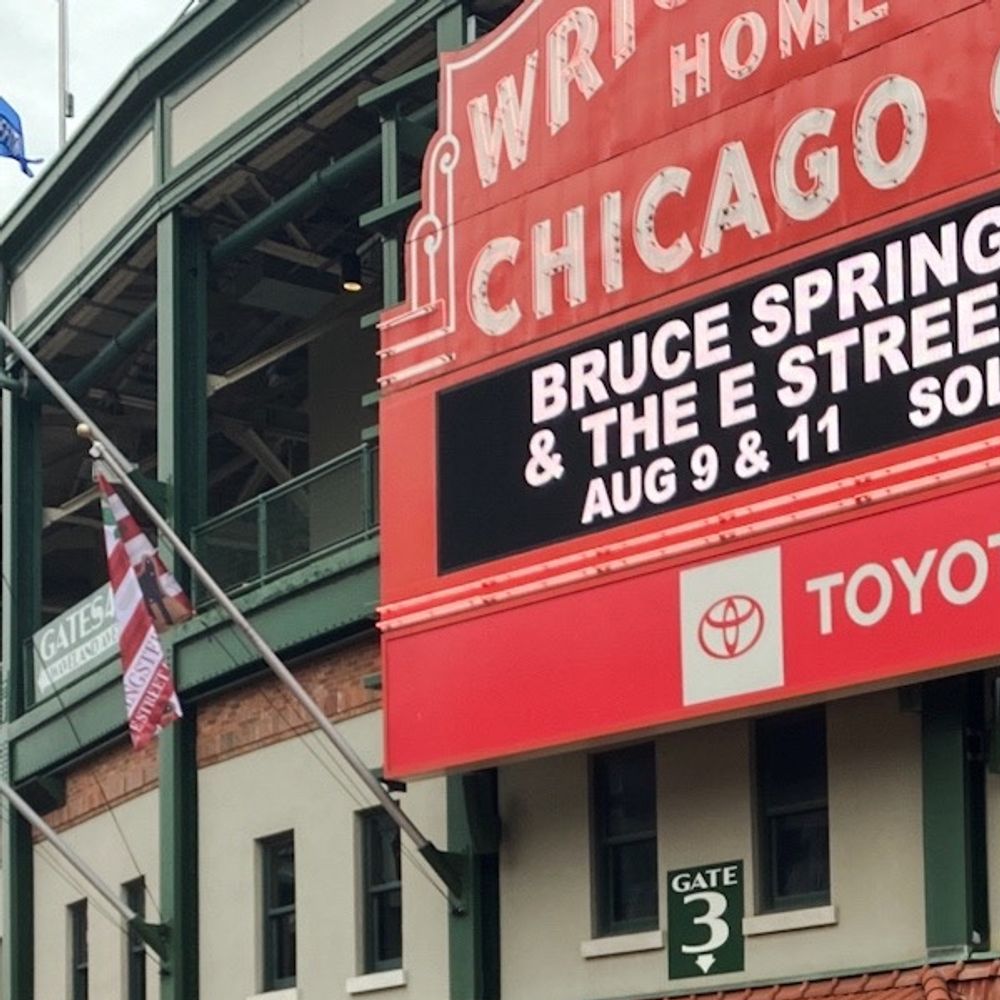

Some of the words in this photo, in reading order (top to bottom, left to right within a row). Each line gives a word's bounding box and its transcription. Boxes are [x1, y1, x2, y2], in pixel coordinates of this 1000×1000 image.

[467, 0, 686, 188] WRI
[467, 75, 926, 336] CHICAGO
[531, 302, 730, 424] BRUCE
[524, 428, 565, 487] &
[582, 381, 699, 468] THE
[718, 364, 756, 428] E
[580, 463, 676, 524] AUG
[690, 444, 719, 491] 9
[734, 430, 770, 479] &
[787, 405, 840, 461] 11
[40, 594, 104, 662] GATES
[671, 865, 738, 893] GATE
[681, 891, 730, 954] 3
